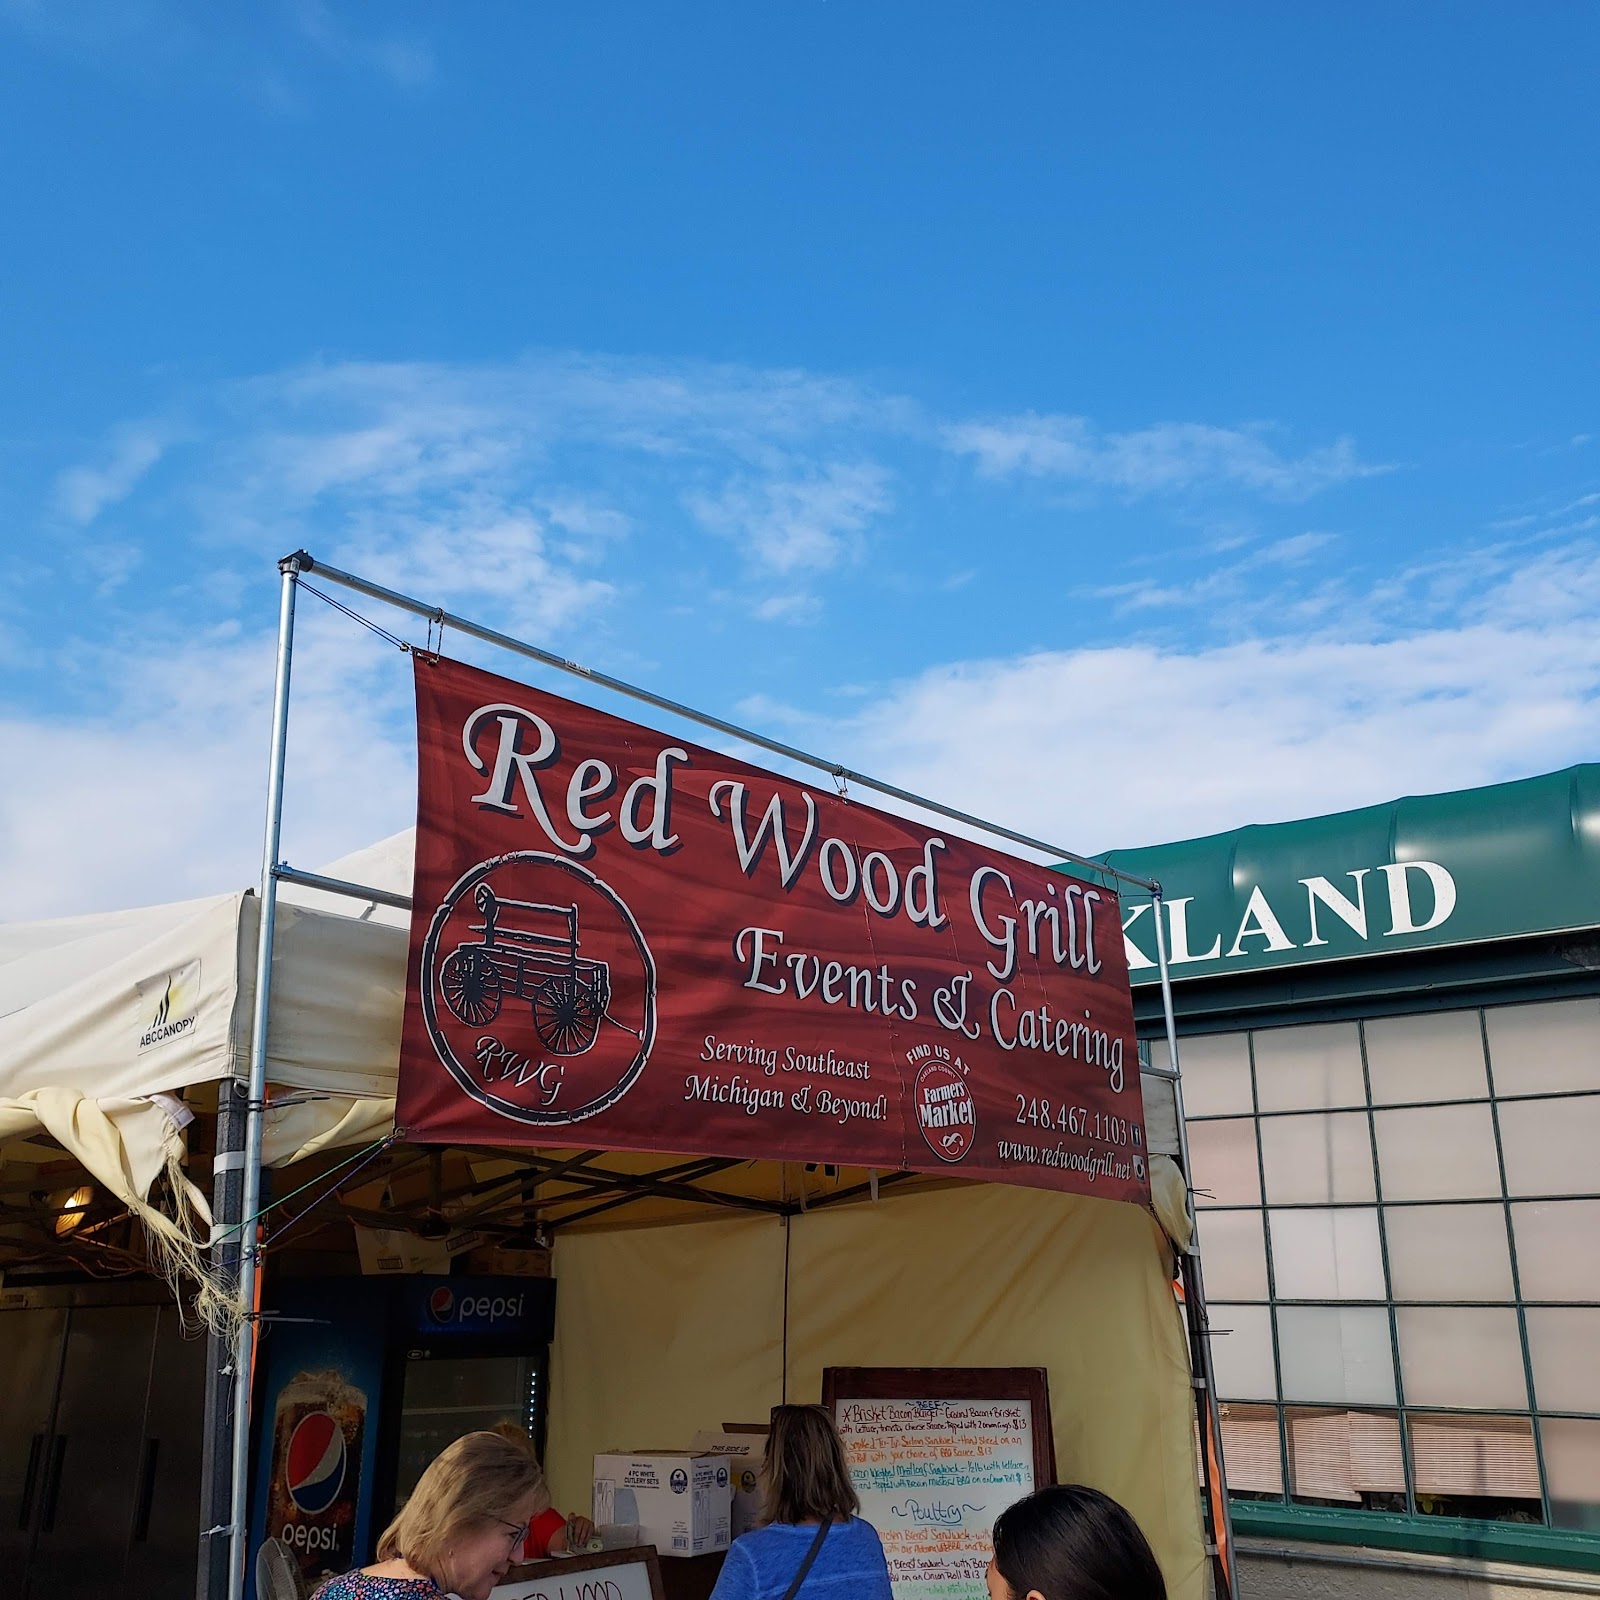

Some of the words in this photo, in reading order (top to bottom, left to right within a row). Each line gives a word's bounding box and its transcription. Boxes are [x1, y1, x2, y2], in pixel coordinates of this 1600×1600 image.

[462, 703, 690, 854] Red
[709, 779, 948, 929] Wood
[969, 866, 1103, 980] Grill
[736, 926, 919, 1021] Events
[932, 971, 981, 1040] &
[991, 988, 1125, 1093] Catering
[139, 1015, 196, 1048] ABCCANOPY
[475, 1035, 565, 1106] RWG
[700, 1034, 778, 1076] Serving
[781, 1046, 871, 1080] Southeast
[905, 1044, 931, 1065] FIND
[934, 1045, 951, 1060] US
[954, 1057, 971, 1076] AT
[920, 1065, 937, 1083] OAKLAND
[938, 1065, 956, 1080] COUNTY
[684, 1074, 785, 1115] Michigan
[790, 1084, 812, 1114] &
[816, 1089, 888, 1124] Beyond!
[919, 1098, 974, 1128] Market
[1015, 1093, 1127, 1147] 248.467.1103
[997, 1140, 1132, 1183] www.redwoodgrill.net
[459, 1293, 525, 1323] pepsi
[887, 1406, 913, 1420] Bacon
[916, 1401, 941, 1410] BEEF
[1013, 1418, 1027, 1431] $13
[976, 1446, 993, 1456] $13
[1012, 1436, 1022, 1446] an
[904, 1498, 962, 1524] Poultry
[281, 1522, 338, 1554] pepsi
[945, 1570, 962, 1580] Roll
[963, 1569, 980, 1580] $13
